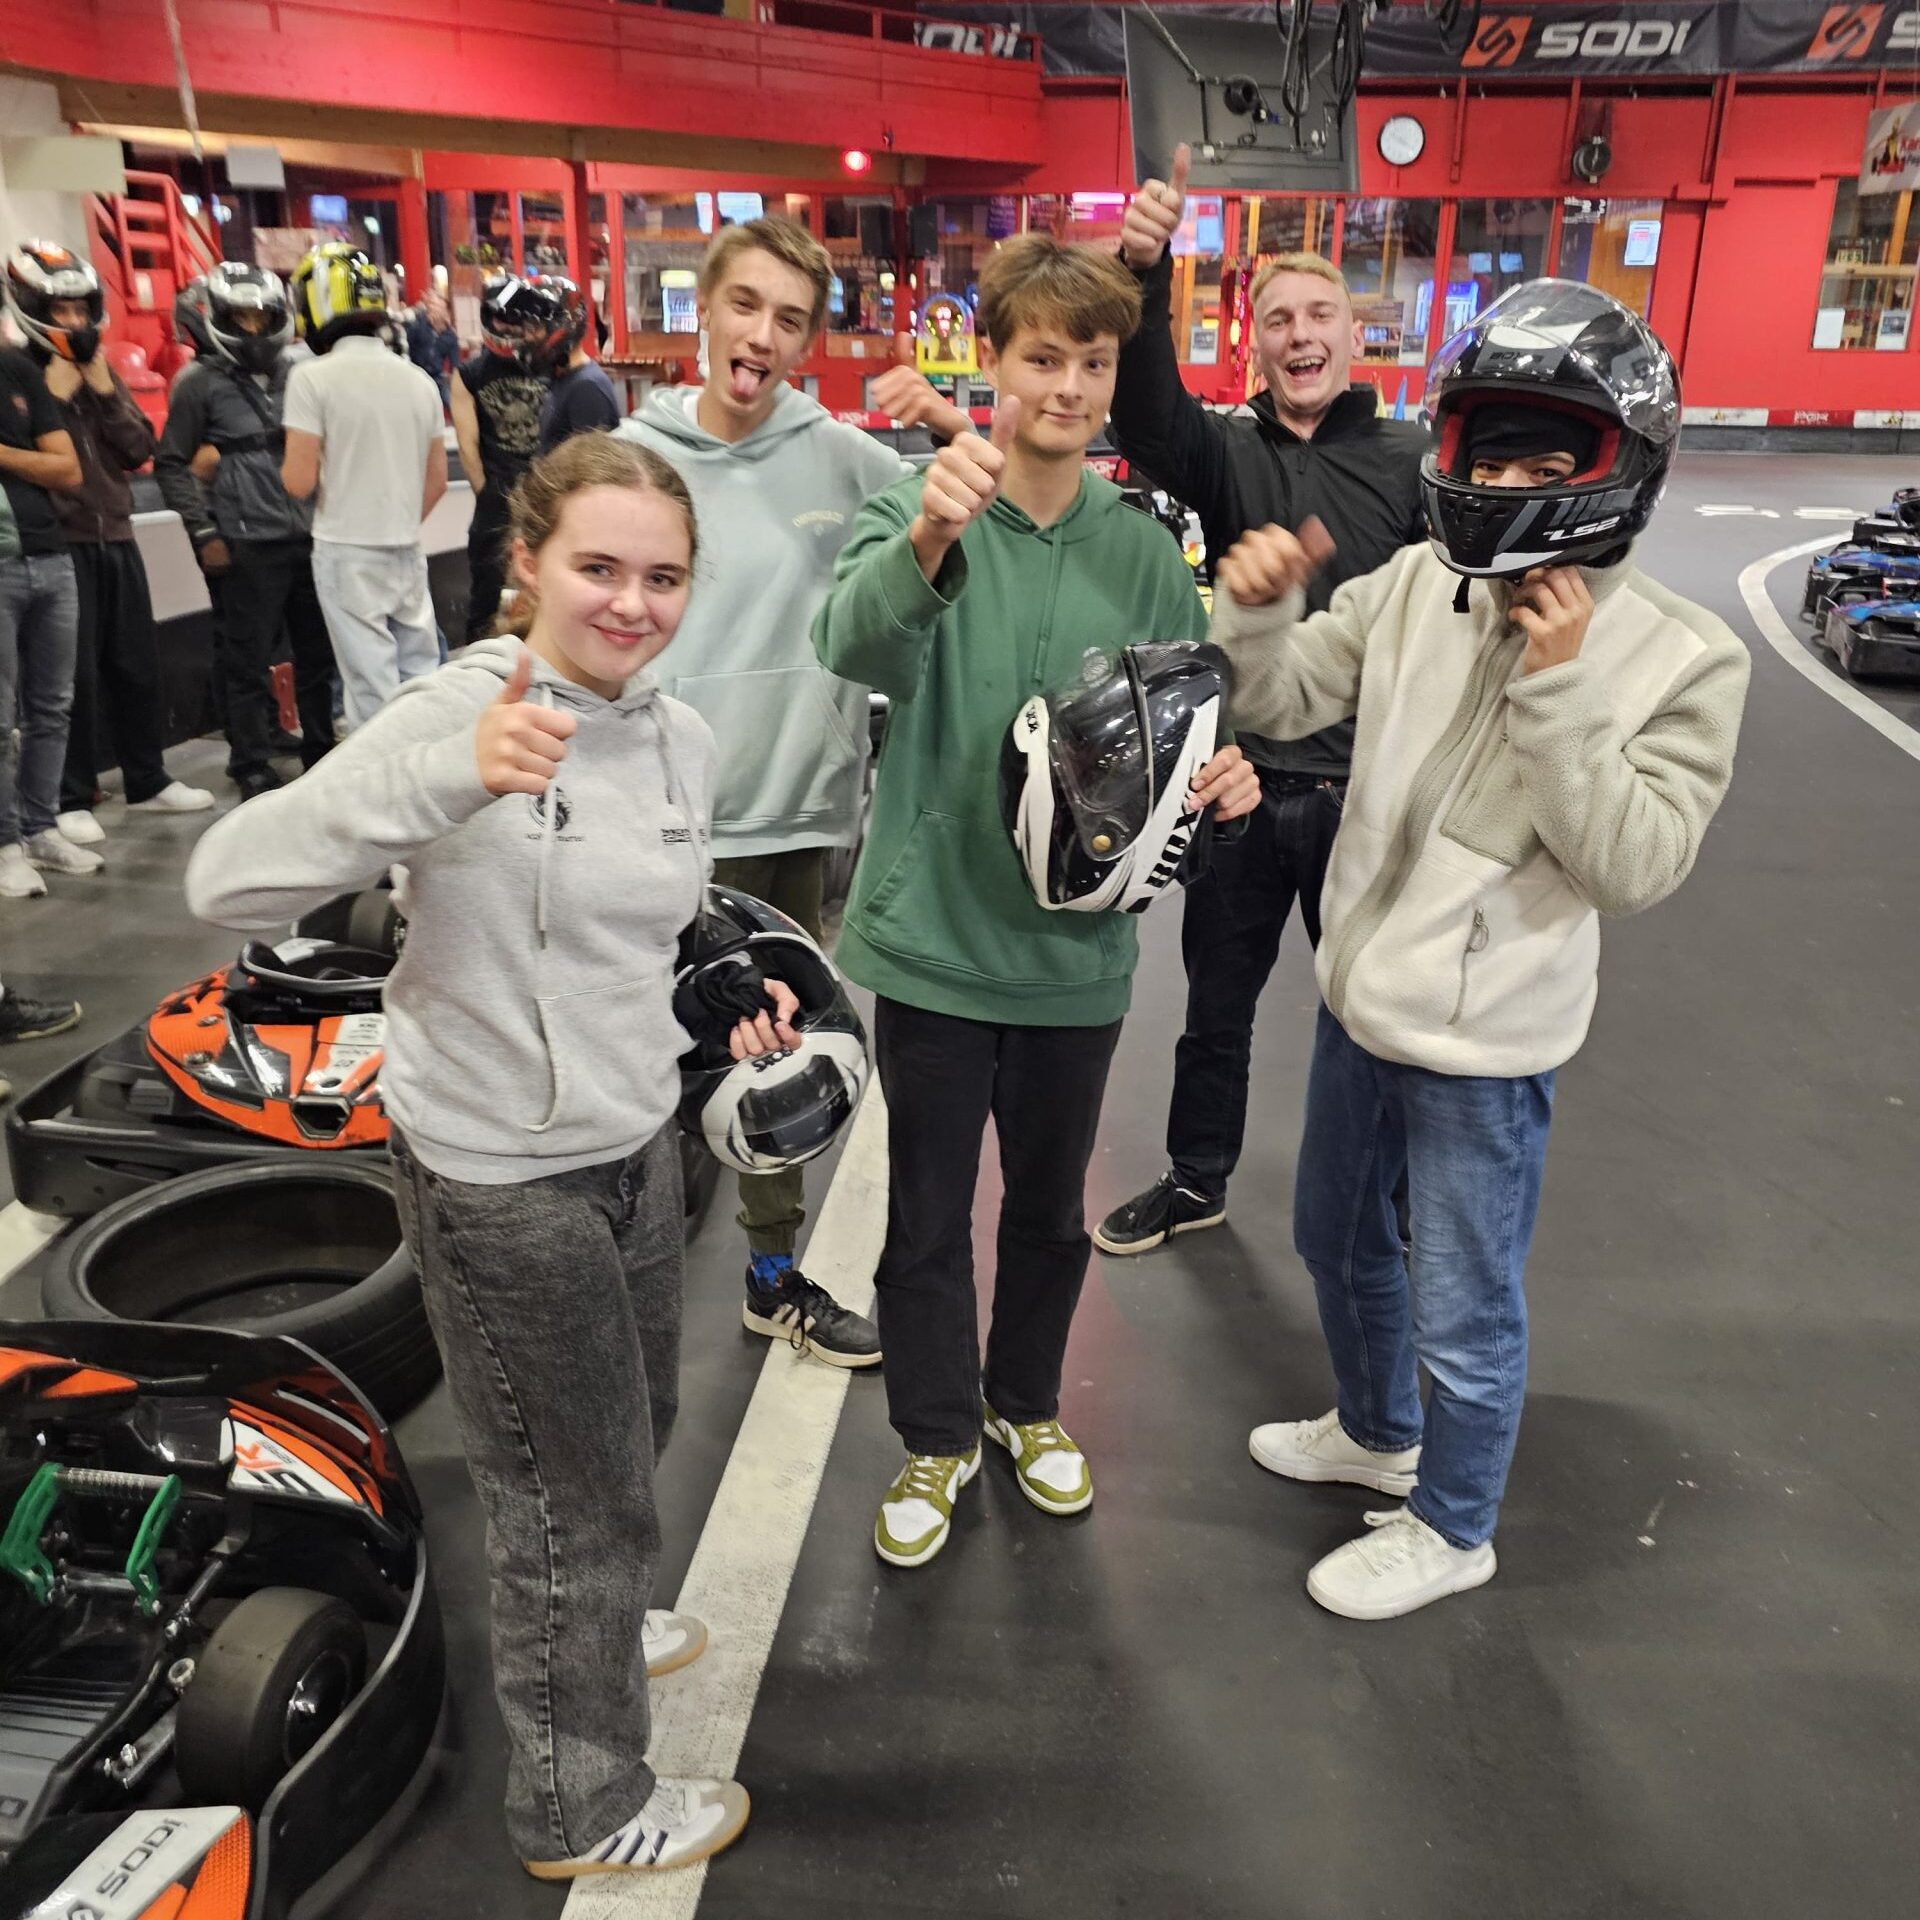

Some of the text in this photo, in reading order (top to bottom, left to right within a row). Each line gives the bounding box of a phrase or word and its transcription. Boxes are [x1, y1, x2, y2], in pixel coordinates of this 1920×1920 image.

[1535, 20, 1691, 58] SODI
[1543, 516, 1620, 541] LS2
[96, 1817, 183, 1898] SODI
